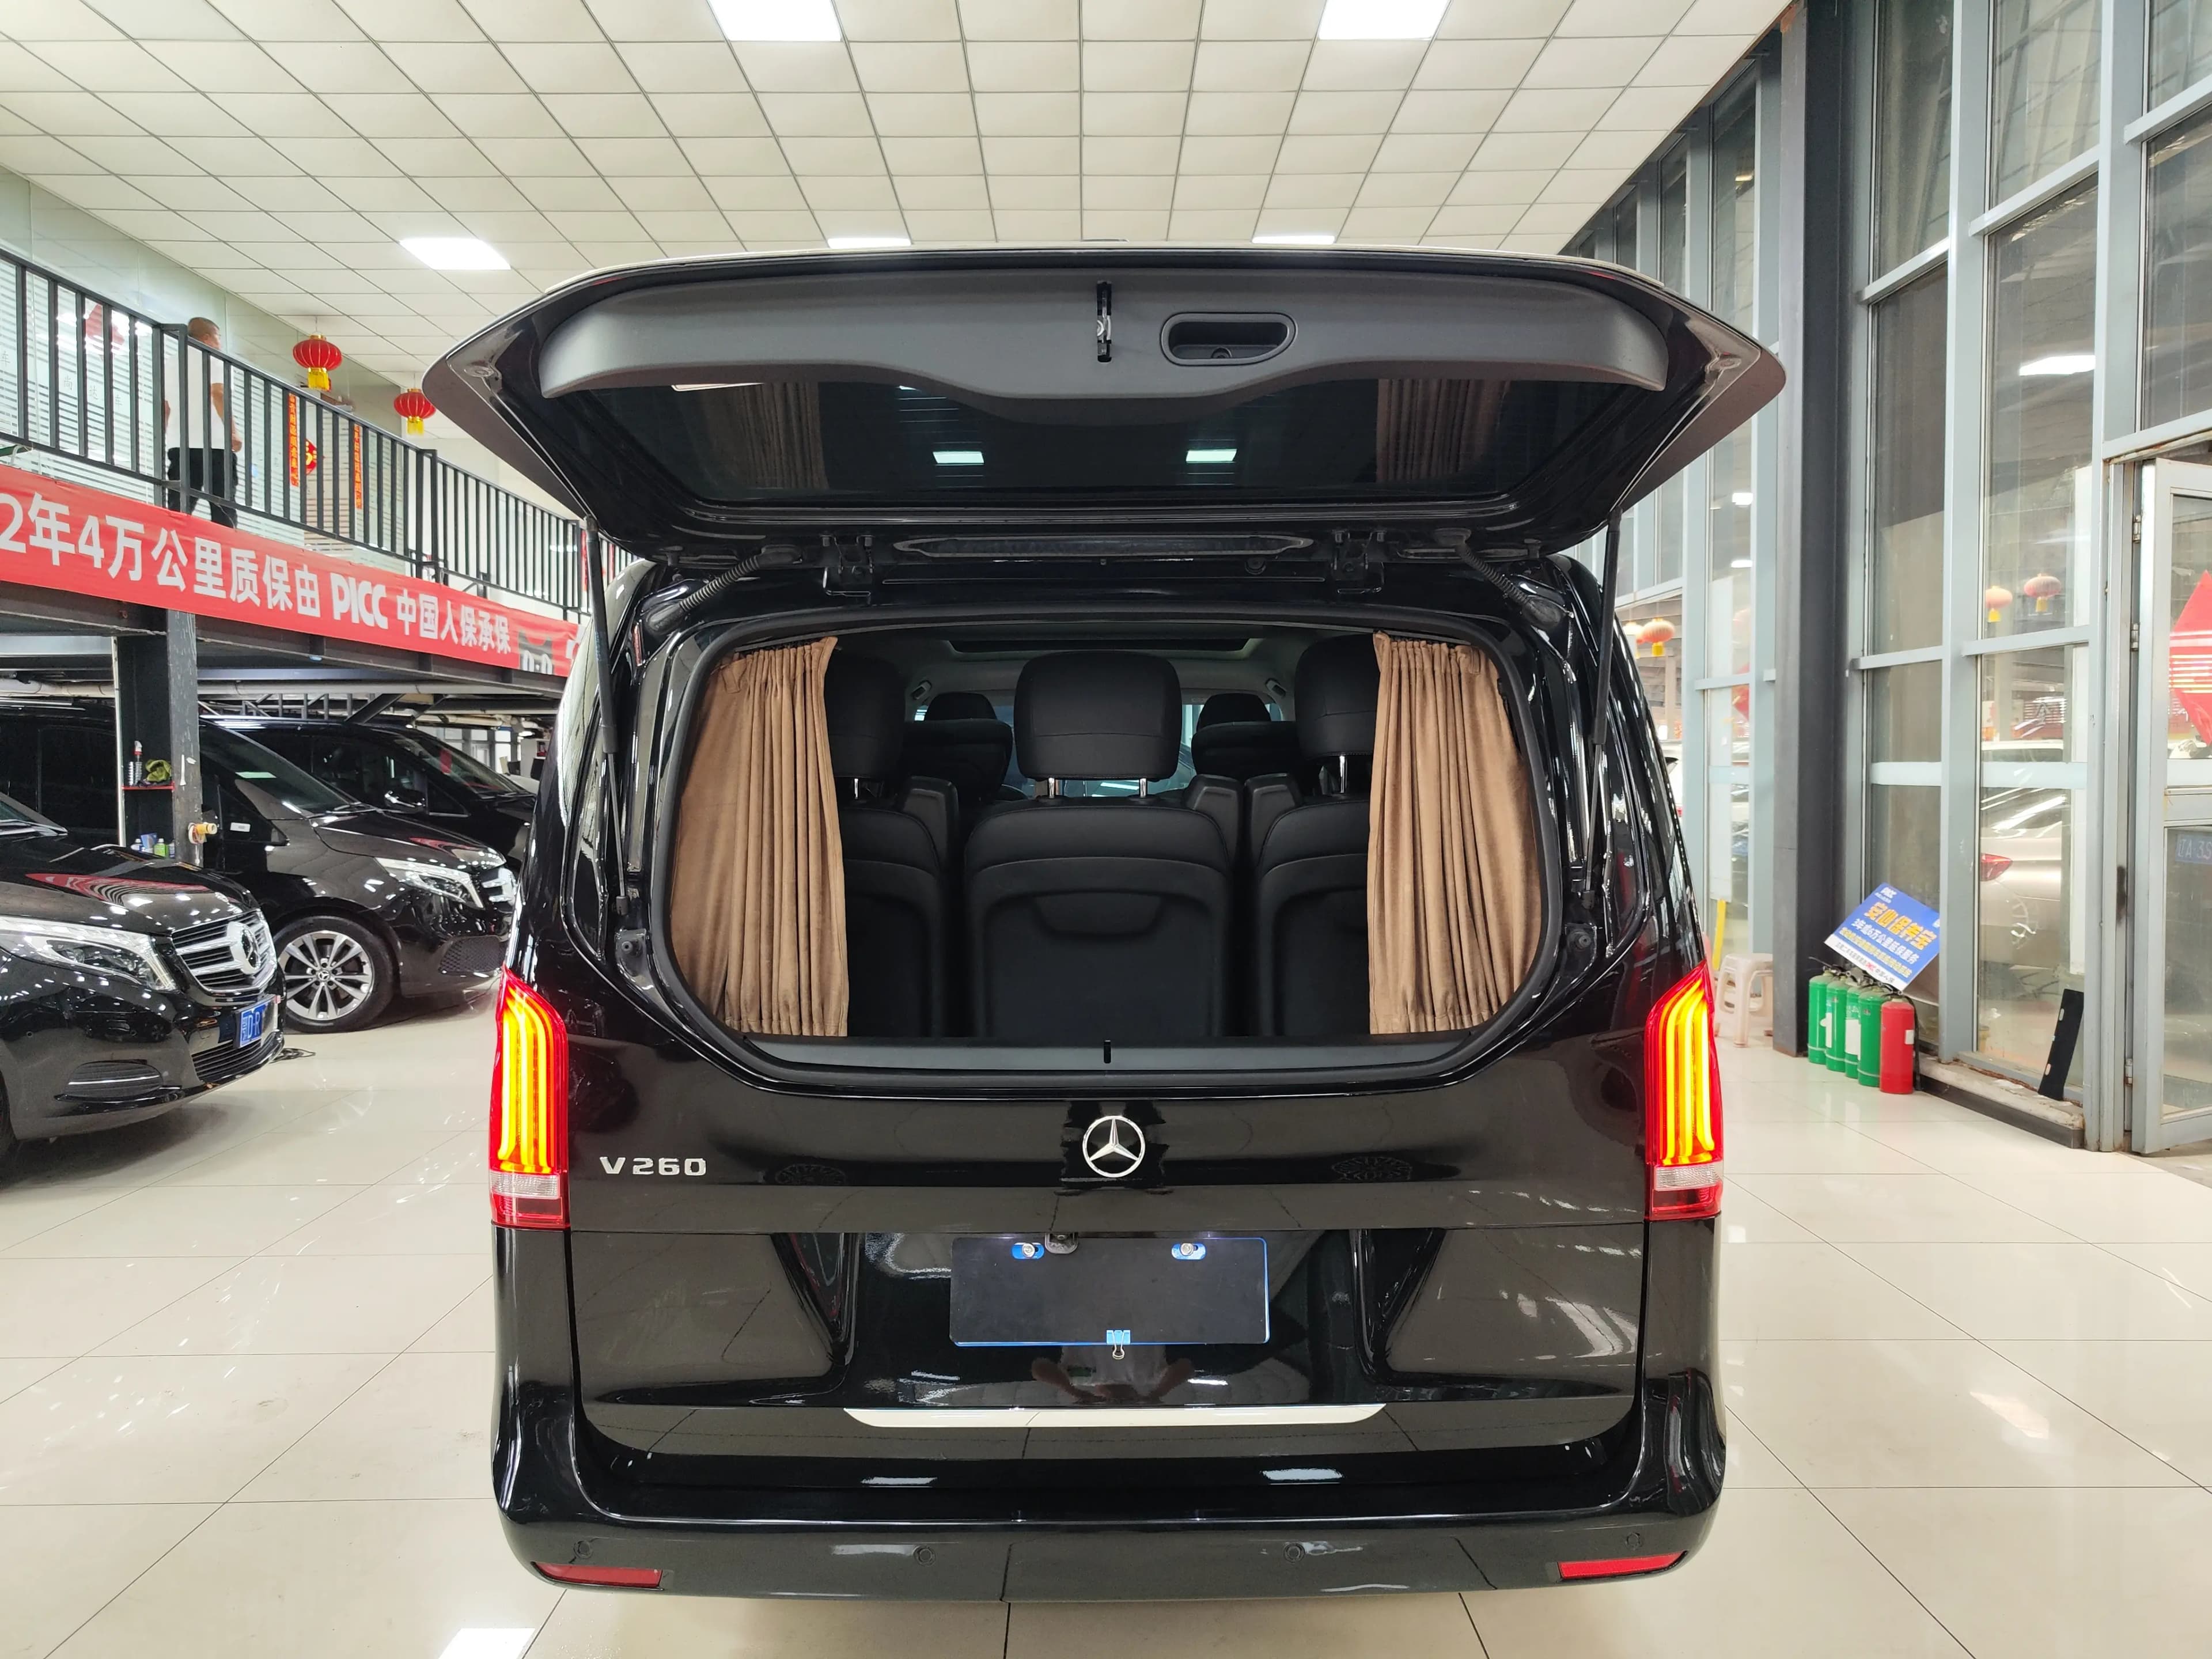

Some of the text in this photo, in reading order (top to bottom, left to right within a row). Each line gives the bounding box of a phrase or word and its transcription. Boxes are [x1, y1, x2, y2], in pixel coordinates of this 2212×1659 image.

[0, 493, 512, 655] 2年4万公里质保由 PICC 中国人保承保
